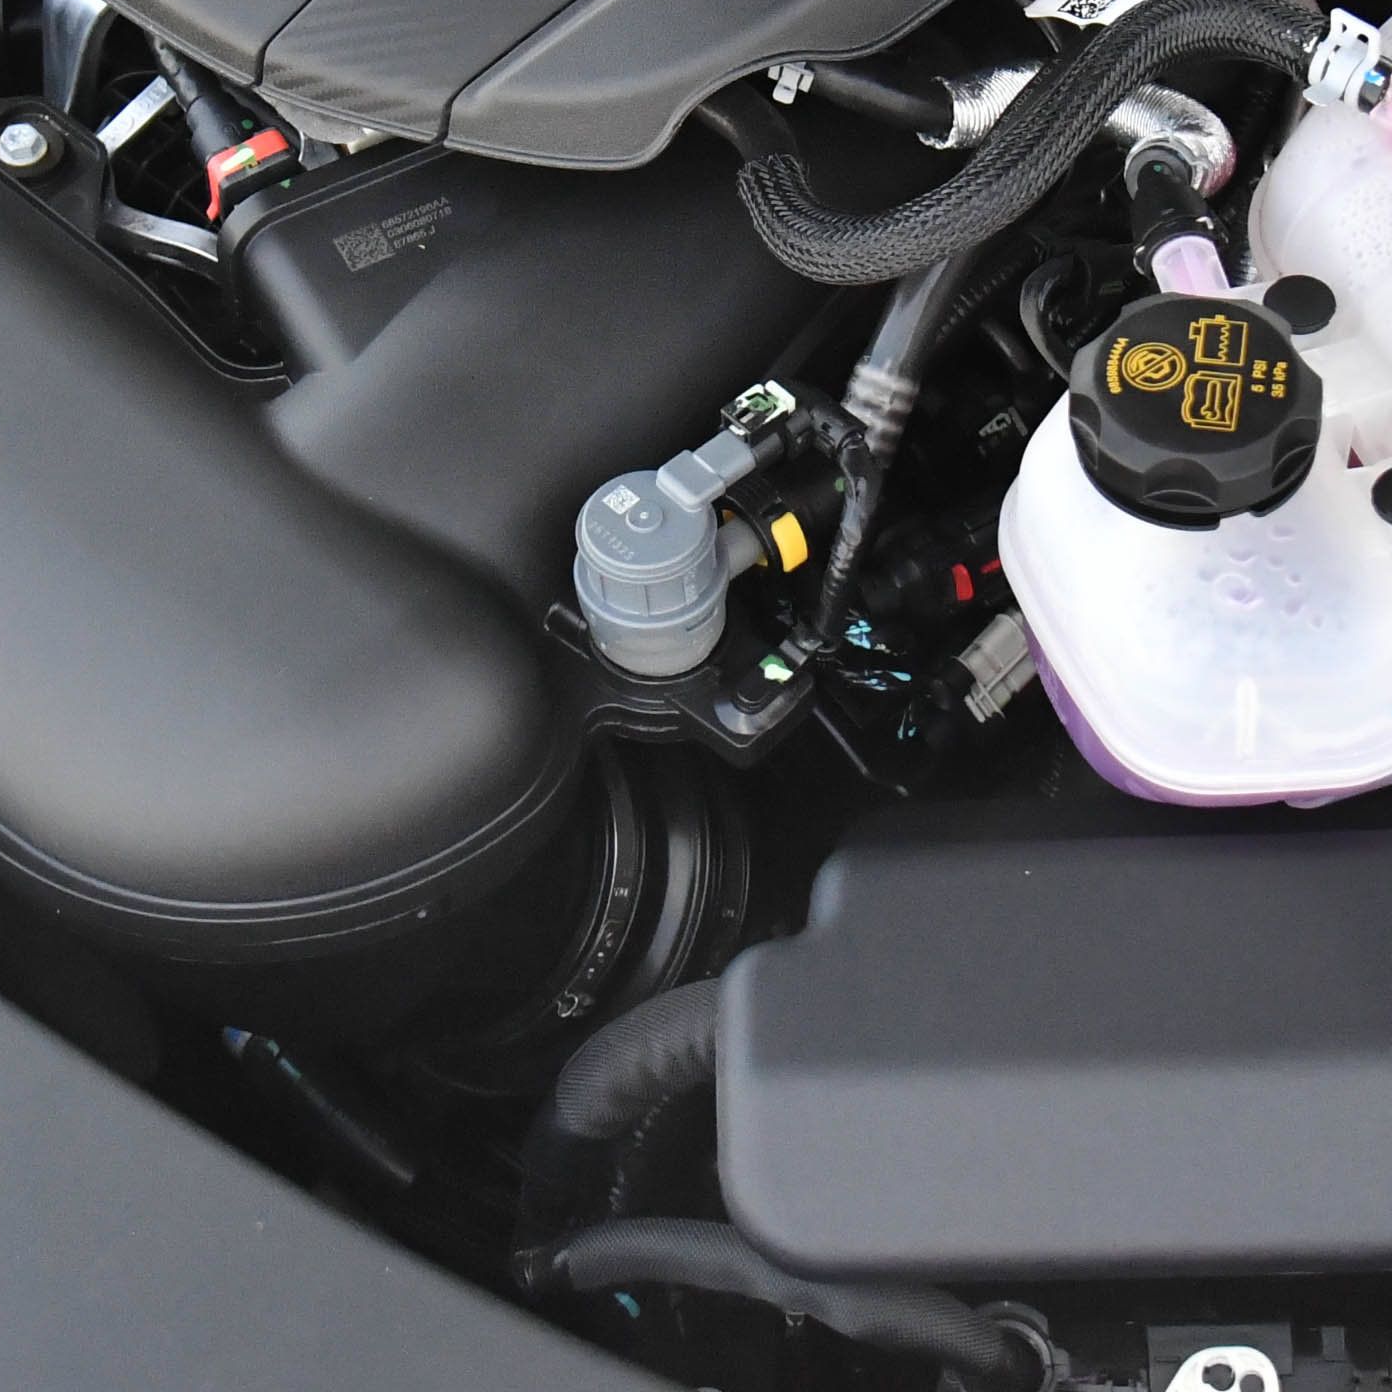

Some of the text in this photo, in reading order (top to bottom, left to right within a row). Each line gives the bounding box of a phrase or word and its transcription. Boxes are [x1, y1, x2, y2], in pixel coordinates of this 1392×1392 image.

[1252, 360, 1268, 379] PSI
[1270, 361, 1289, 398] 35 kPa
